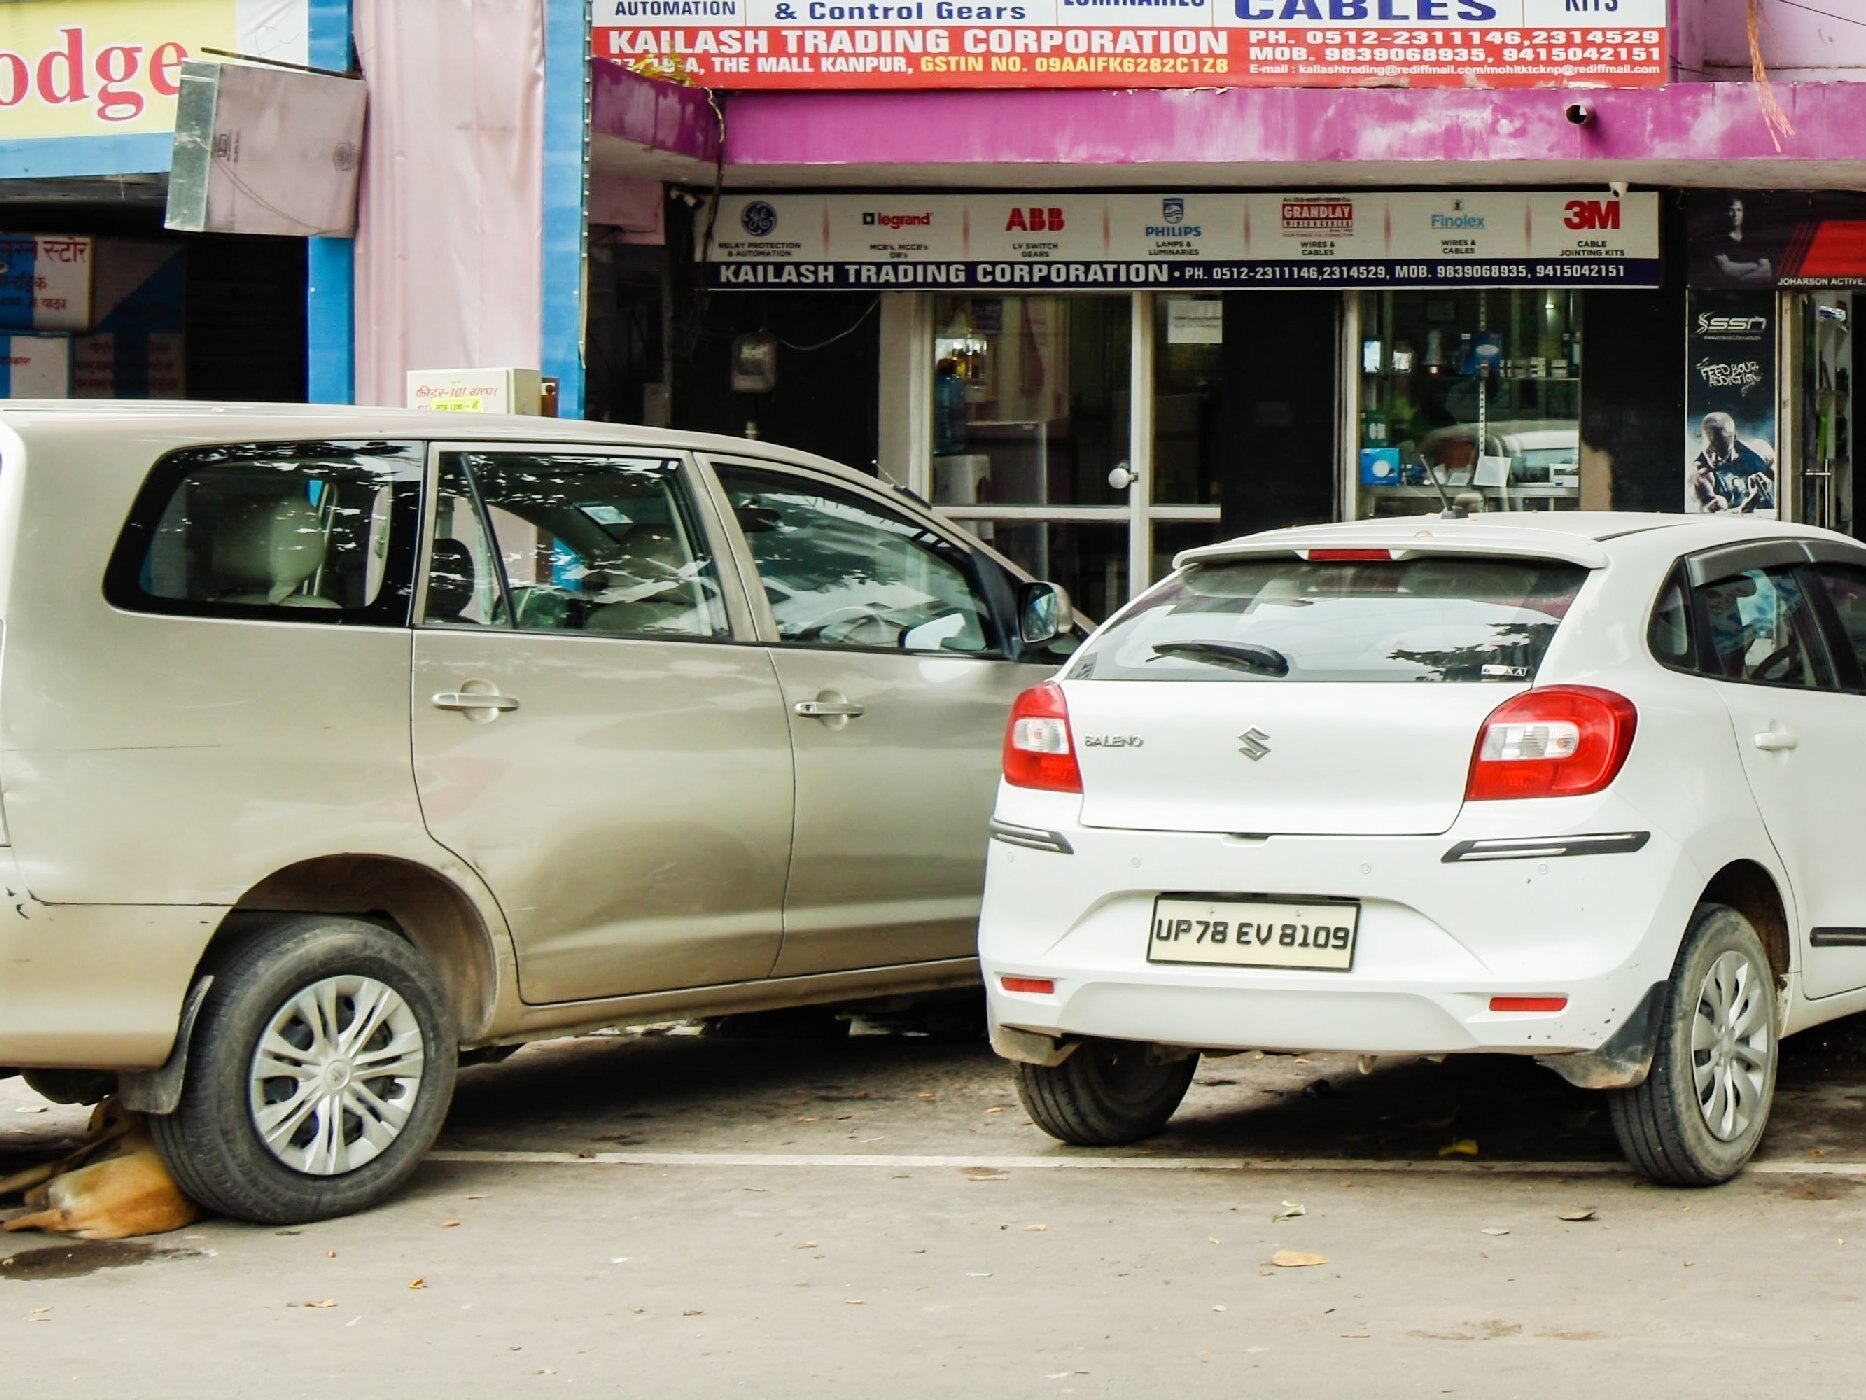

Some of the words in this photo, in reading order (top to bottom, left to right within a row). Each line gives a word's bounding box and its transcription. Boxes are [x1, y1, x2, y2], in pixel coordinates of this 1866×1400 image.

[614, 0, 737, 16] AUTOMATION
[774, 2, 797, 20] &
[809, 2, 924, 20] Control
[936, 2, 1026, 20] Gears
[608, 30, 769, 54] KAILASH
[781, 30, 950, 54] TRADING
[963, 29, 1229, 54] CORPORATION
[1249, 30, 1296, 44] PH.
[1306, 30, 1660, 46] 0512-2311146,2314529
[1249, 47, 1316, 62] MOB.
[1324, 47, 1494, 63] 9839068935,
[1502, 47, 1661, 62] 9415042151
[711, 57, 750, 73] THE
[757, 57, 815, 73] MALL
[821, 57, 914, 75] KANPUR,
[920, 57, 984, 73] GSTIN
[991, 57, 1028, 73] NO.
[1035, 57, 1229, 73] 09AAIFK6282C1Z8
[1249, 64, 1289, 74] E-mail
[1005, 207, 1065, 232] ABB
[1283, 205, 1351, 218] GRANDLAY
[1563, 200, 1621, 229] 3M
[878, 213, 930, 229] legrand
[1431, 214, 1485, 228] Finolex
[1145, 226, 1202, 237] PHILIPS
[1604, 249, 1625, 257] KITS
[719, 264, 836, 284] KAILASH
[845, 264, 967, 283] TRADING
[976, 263, 1169, 284] CORPORATION
[1184, 265, 1208, 280] PH.
[1395, 263, 1432, 279] MOB.
[1437, 263, 1532, 281] 9839068935,
[1535, 263, 1625, 279] 9415042151
[1083, 735, 1144, 748] BALENO
[1236, 921, 1273, 946] EV
[1278, 923, 1351, 950] 8109
